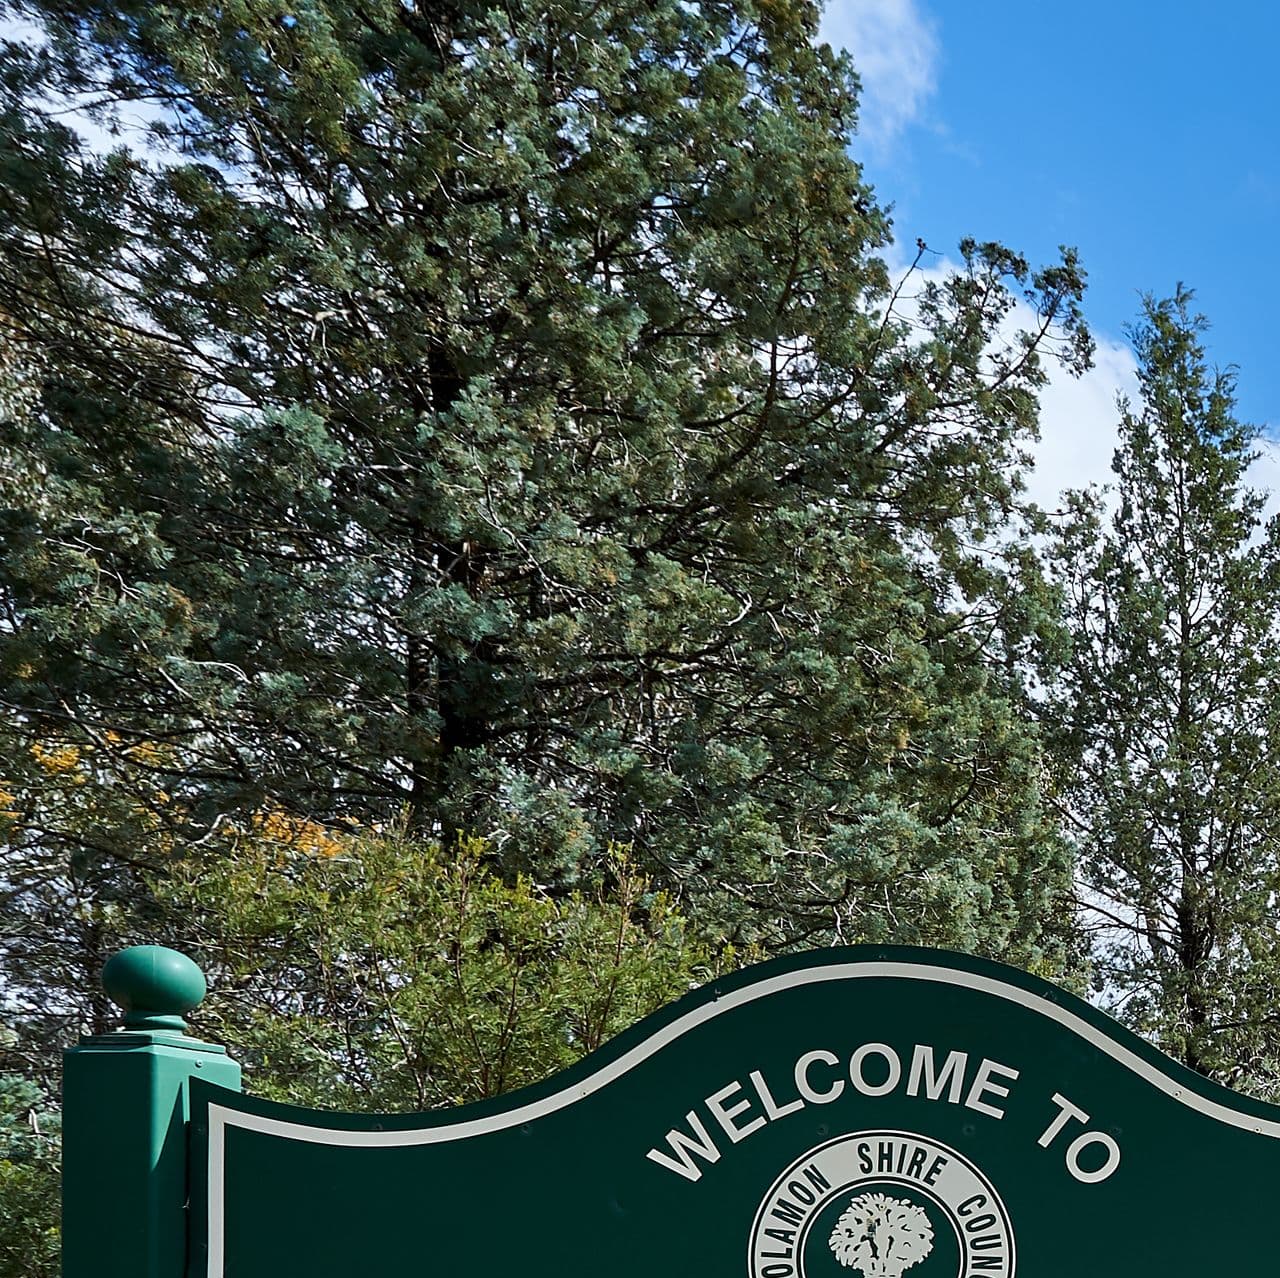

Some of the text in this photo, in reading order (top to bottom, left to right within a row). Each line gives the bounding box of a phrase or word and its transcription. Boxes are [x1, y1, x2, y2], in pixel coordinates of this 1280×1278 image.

[646, 1043, 1121, 1183] WELCOME TO
[858, 1142, 948, 1186] SHIRE
